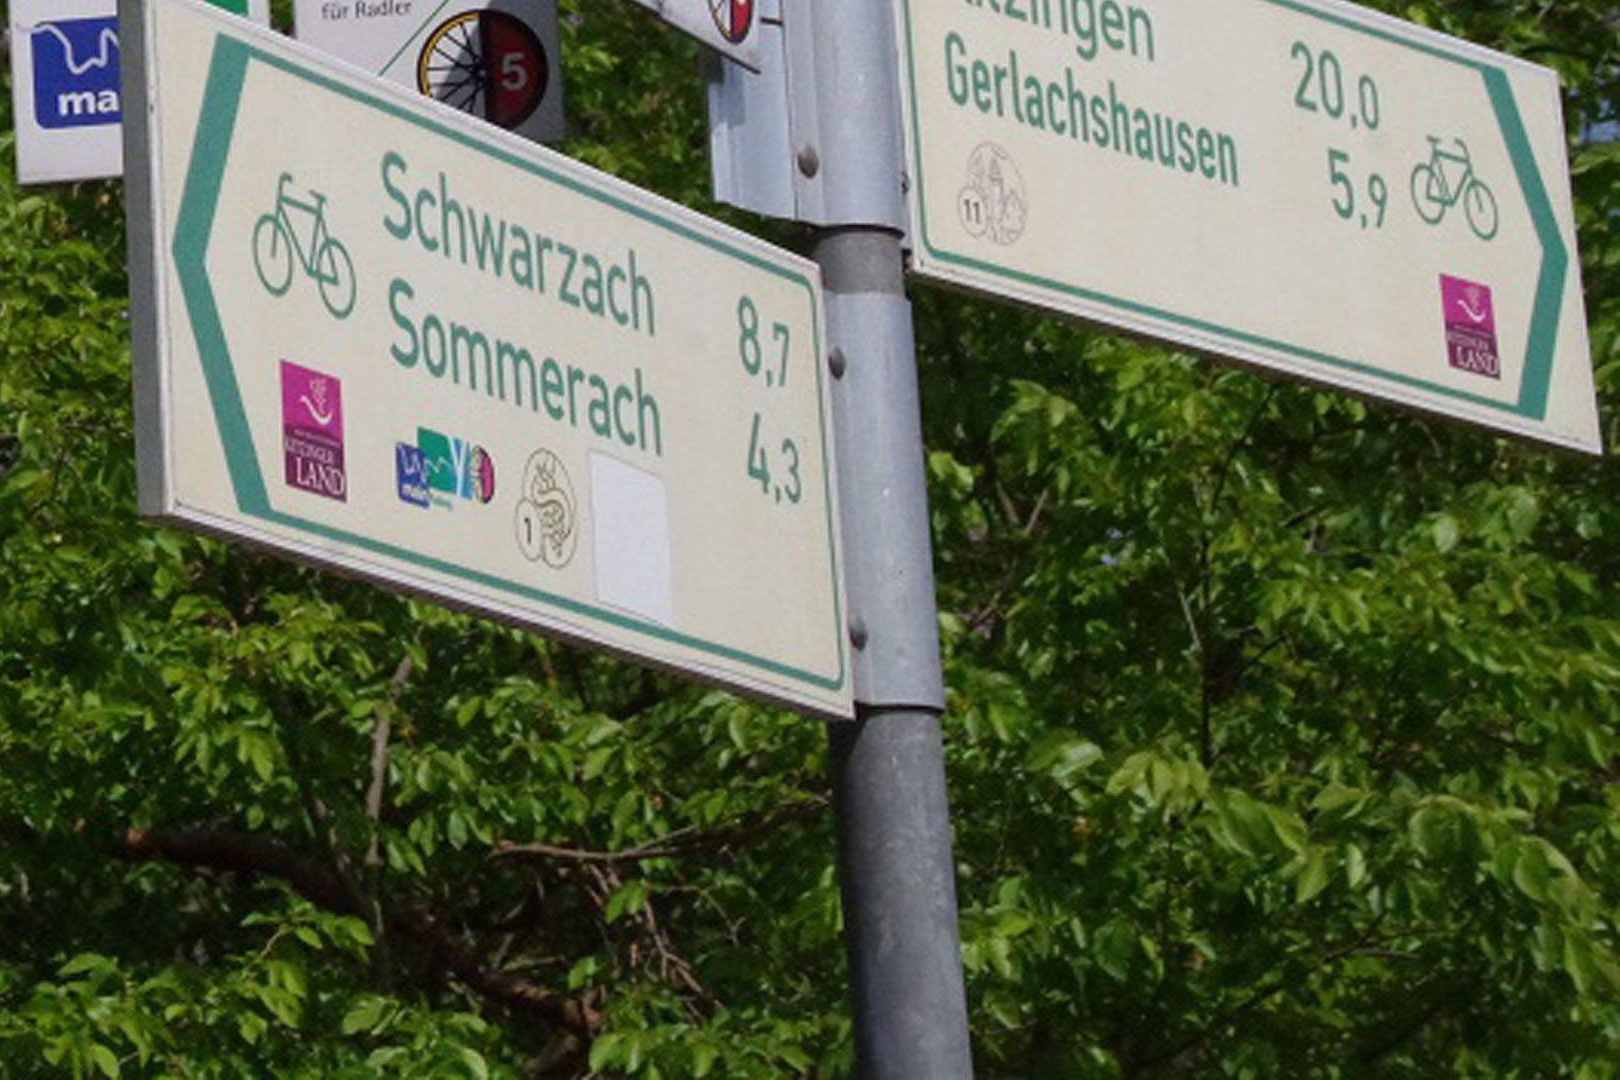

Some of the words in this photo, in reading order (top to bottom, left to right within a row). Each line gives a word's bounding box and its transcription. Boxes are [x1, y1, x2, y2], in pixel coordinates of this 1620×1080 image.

[321, 0, 350, 20] für
[501, 54, 528, 90] 5
[1290, 40, 1380, 132] 20,0
[57, 88, 120, 117] ma
[944, 32, 1239, 187] Gerlachshausen
[1328, 147, 1388, 230] 5,9
[962, 197, 981, 225] 11
[381, 150, 656, 337] Schwarzach
[736, 295, 791, 388] 8,7
[388, 278, 664, 457] Sommerach
[746, 412, 802, 506] 4,3
[295, 456, 346, 496] LAND
[522, 515, 534, 544] 1
